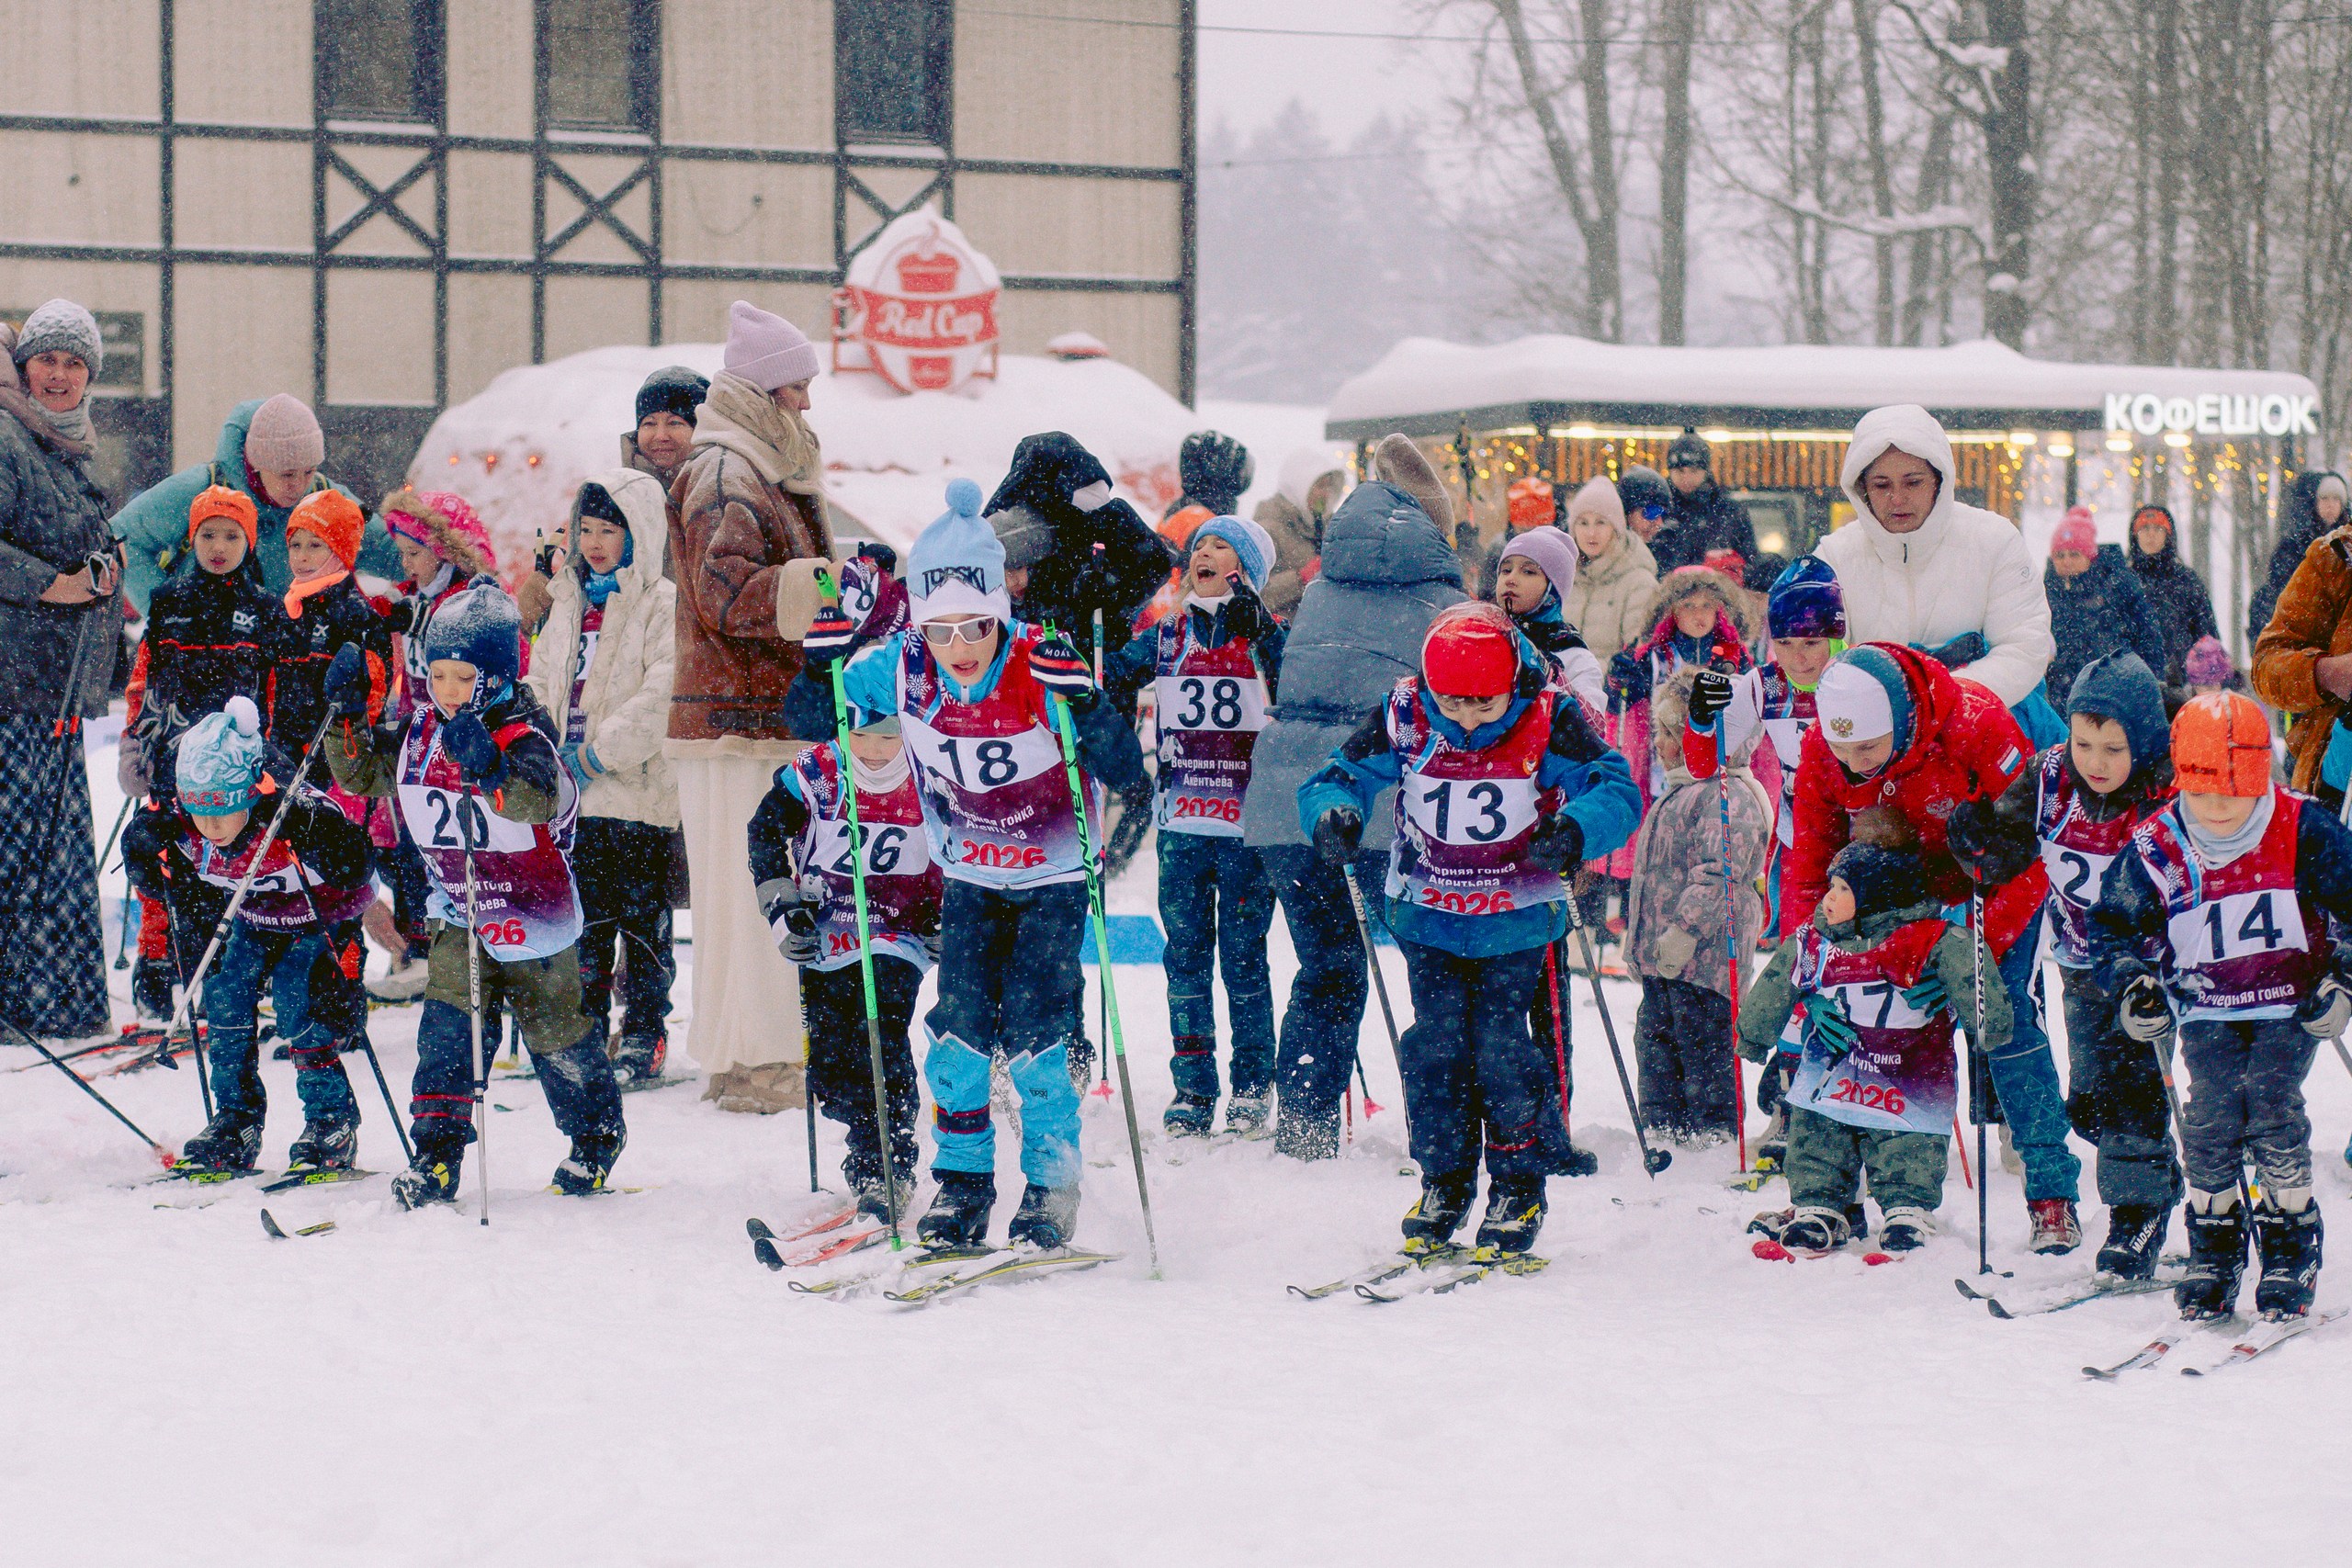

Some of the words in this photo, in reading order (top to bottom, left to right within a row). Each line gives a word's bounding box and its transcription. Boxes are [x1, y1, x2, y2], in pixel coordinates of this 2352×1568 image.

[876, 299, 934, 338] Red
[936, 302, 984, 343] Cup
[2105, 393, 2318, 435] КОФЕШОК
[1045, 648, 1071, 658] MOAX
[1702, 672, 1727, 684] MOAX
[1177, 678, 1242, 728] 38
[938, 739, 1018, 787] 18
[1171, 756, 1215, 772] Вечерняя
[1217, 760, 1247, 771] гонка
[1182, 773, 1233, 788] Акентьева
[426, 789, 490, 849] 20
[1001, 805, 1035, 829] гонка
[1174, 795, 1240, 823] 2026
[1424, 782, 1507, 841] 13
[831, 824, 908, 874] 26
[962, 839, 1047, 869] 2026
[1418, 852, 1474, 875] Вечерняя
[1477, 862, 1516, 875] гонка
[2060, 852, 2092, 907] 2
[1421, 887, 1514, 915] 2026
[281, 911, 317, 926] гонка
[2204, 892, 2283, 960] 14
[1974, 901, 1985, 1030] MADSHUS
[471, 957, 481, 1013] X-TOUR
[2198, 990, 2255, 1008] Вечерняя
[2258, 984, 2295, 1001] гонка
[1837, 984, 1894, 1028] 17
[1868, 1052, 1902, 1066] гонка
[1830, 1077, 1905, 1114] 2026
[323, 1122, 351, 1146] SPINE
[189, 1172, 232, 1184] FISCHER
[304, 1172, 338, 1185] FISCHER
[2195, 1218, 2234, 1226] SPINE
[2298, 1259, 2317, 1287] SPINE
